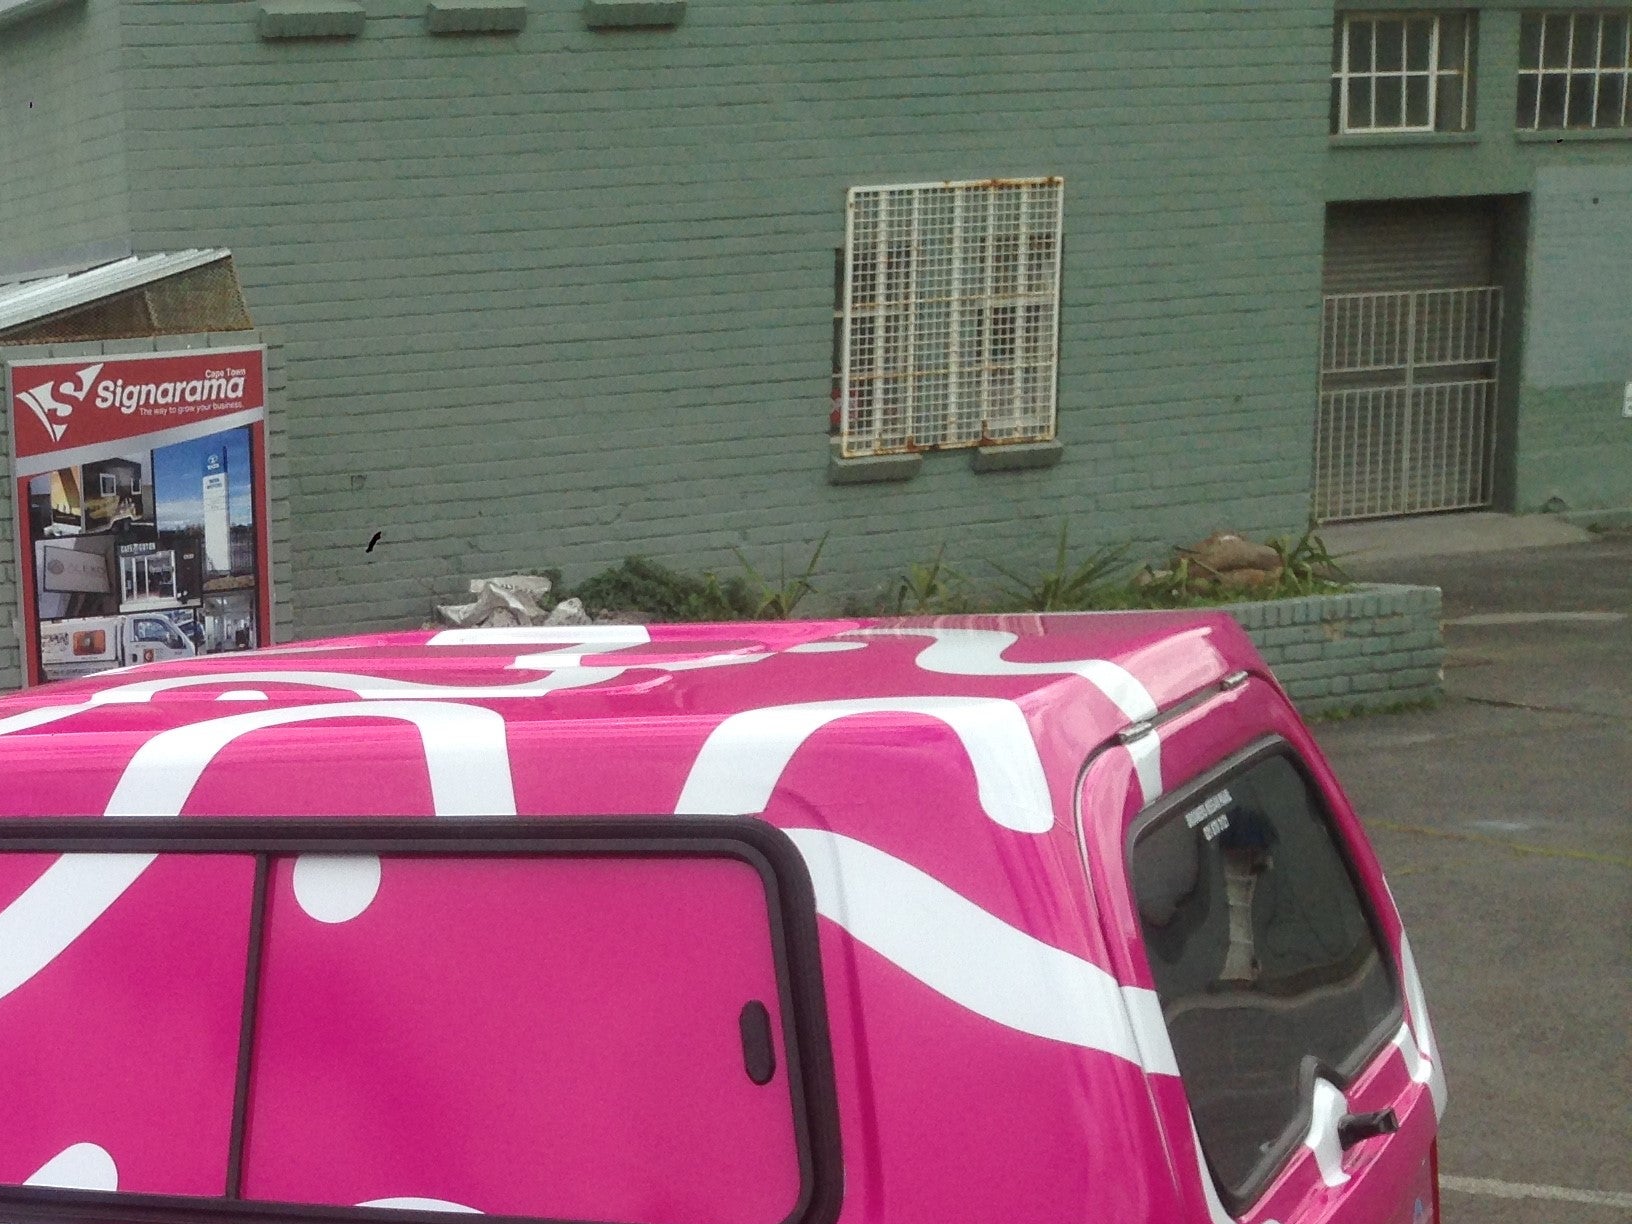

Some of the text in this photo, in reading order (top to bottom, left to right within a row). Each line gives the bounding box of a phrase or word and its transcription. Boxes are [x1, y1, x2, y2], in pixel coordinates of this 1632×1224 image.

[205, 367, 246, 379] Cape Town
[95, 376, 246, 414] Signarama
[139, 407, 153, 416] The
[153, 406, 168, 416] way
[169, 405, 177, 414] to
[178, 406, 195, 415] grow
[196, 404, 213, 413] your
